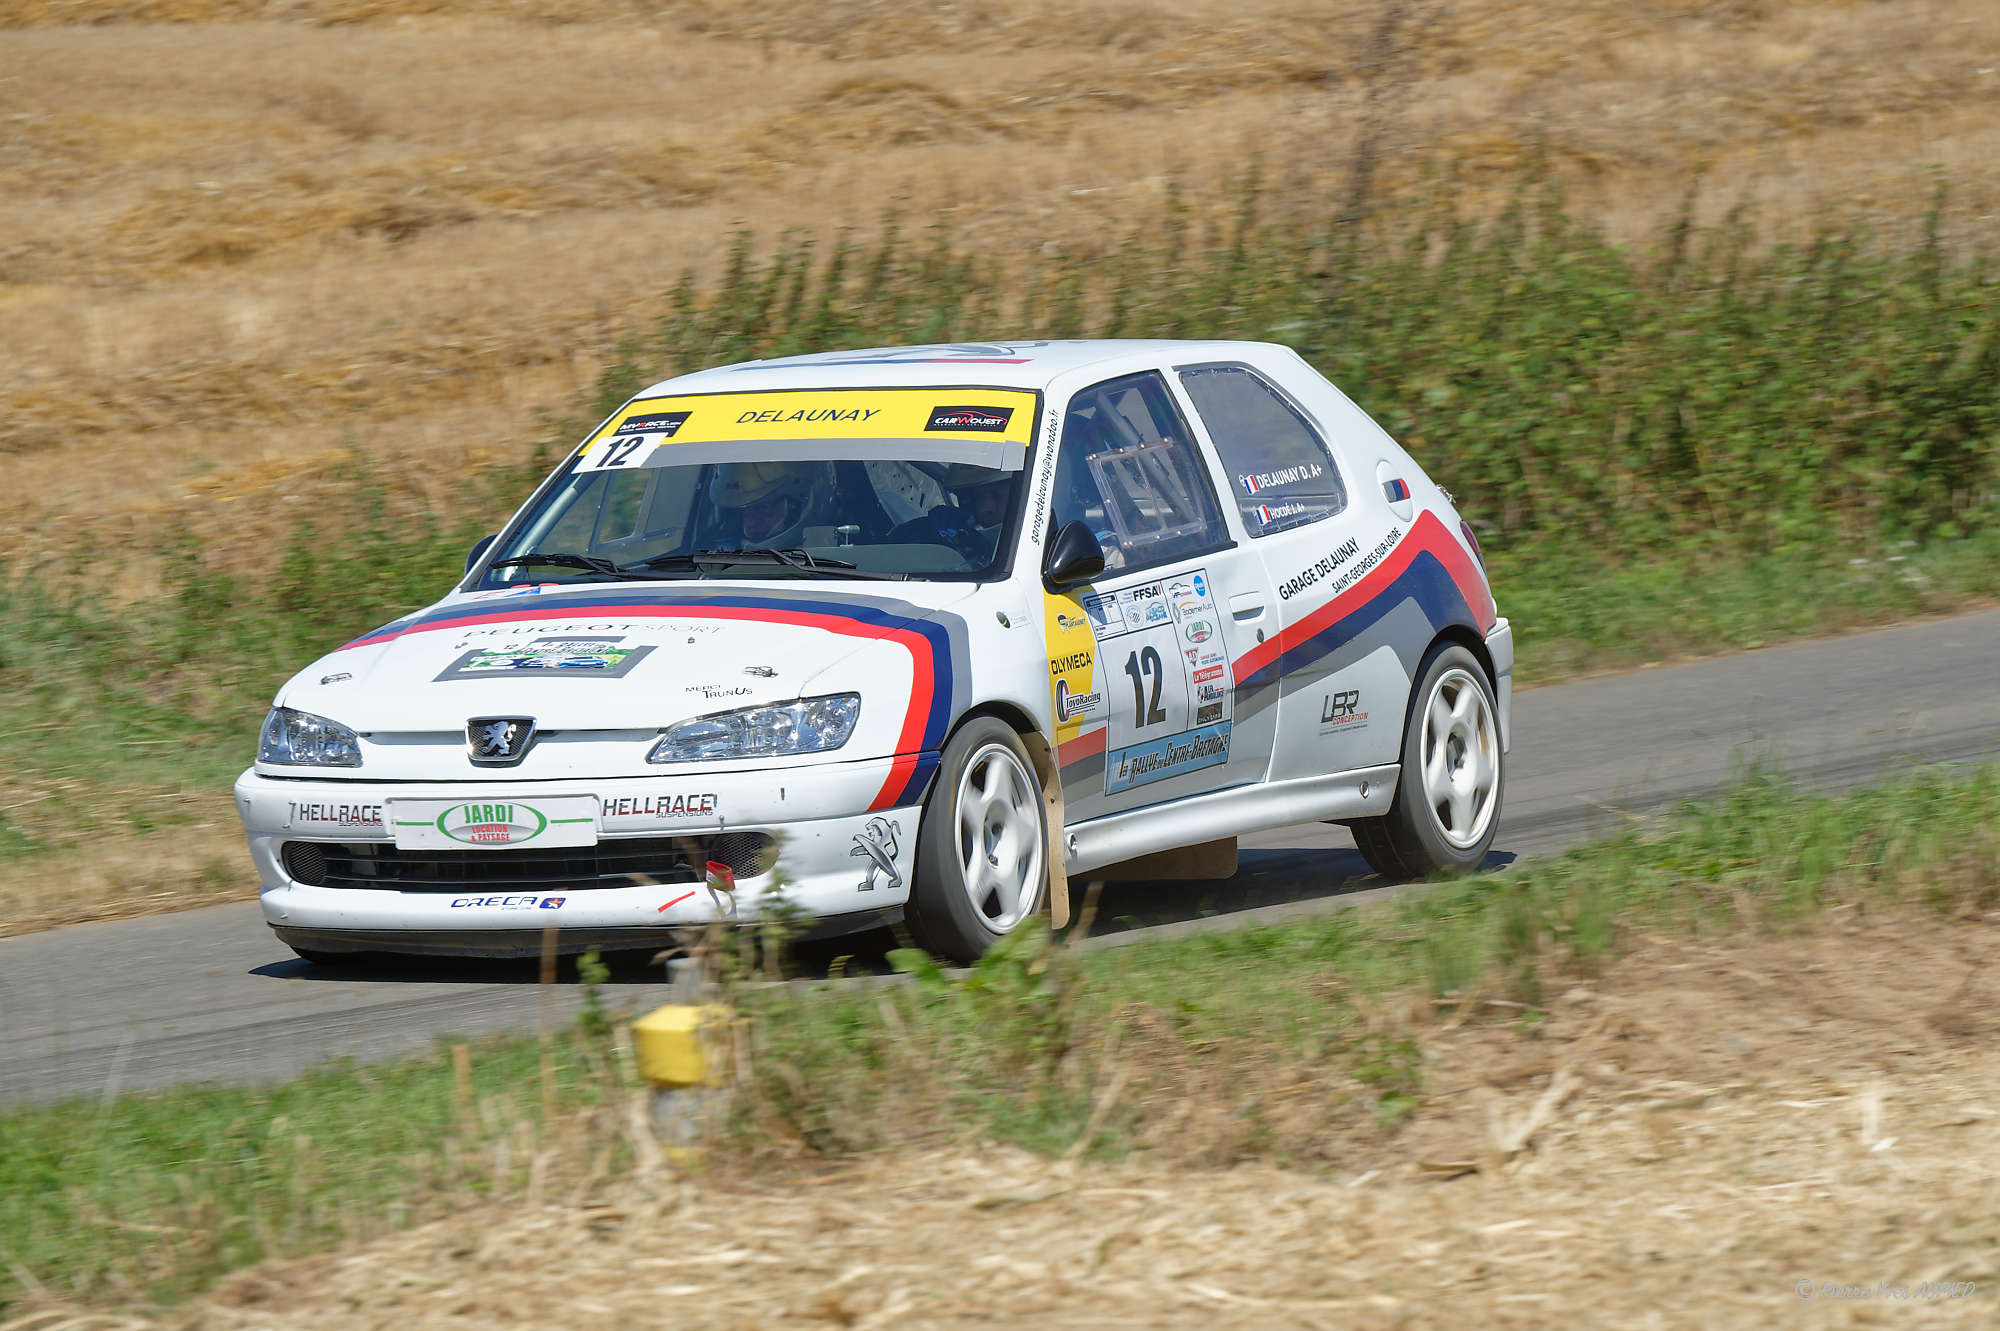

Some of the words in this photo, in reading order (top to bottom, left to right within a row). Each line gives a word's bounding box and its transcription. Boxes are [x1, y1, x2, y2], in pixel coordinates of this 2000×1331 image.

[736, 409, 881, 423] DELAUNAY
[595, 436, 645, 468] 12
[1256, 466, 1301, 489] DELAUNAY
[1299, 465, 1312, 480] D.
[1279, 568, 1319, 601] GARAGE
[1314, 536, 1360, 578] DELAUNAY
[1331, 527, 1402, 594] SAINT-GEORGES-SUR-LOIRE
[1133, 585, 1159, 602] FFSA
[464, 624, 638, 638] PEUGEOT
[1051, 652, 1093, 676] OLYMECA
[685, 684, 721, 692] MERCI
[1124, 646, 1166, 729] 12
[1320, 690, 1360, 723] LBR
[1332, 712, 1368, 726] CONCEPTION
[299, 803, 383, 823] HELLRACE
[464, 804, 513, 824] JARDI
[603, 793, 716, 817] HELLRACE
[656, 808, 713, 819] SUSPENSIONS
[472, 824, 508, 834] LOCATION
[478, 832, 512, 842] PAYSAGE
[450, 896, 538, 908] ORECA
